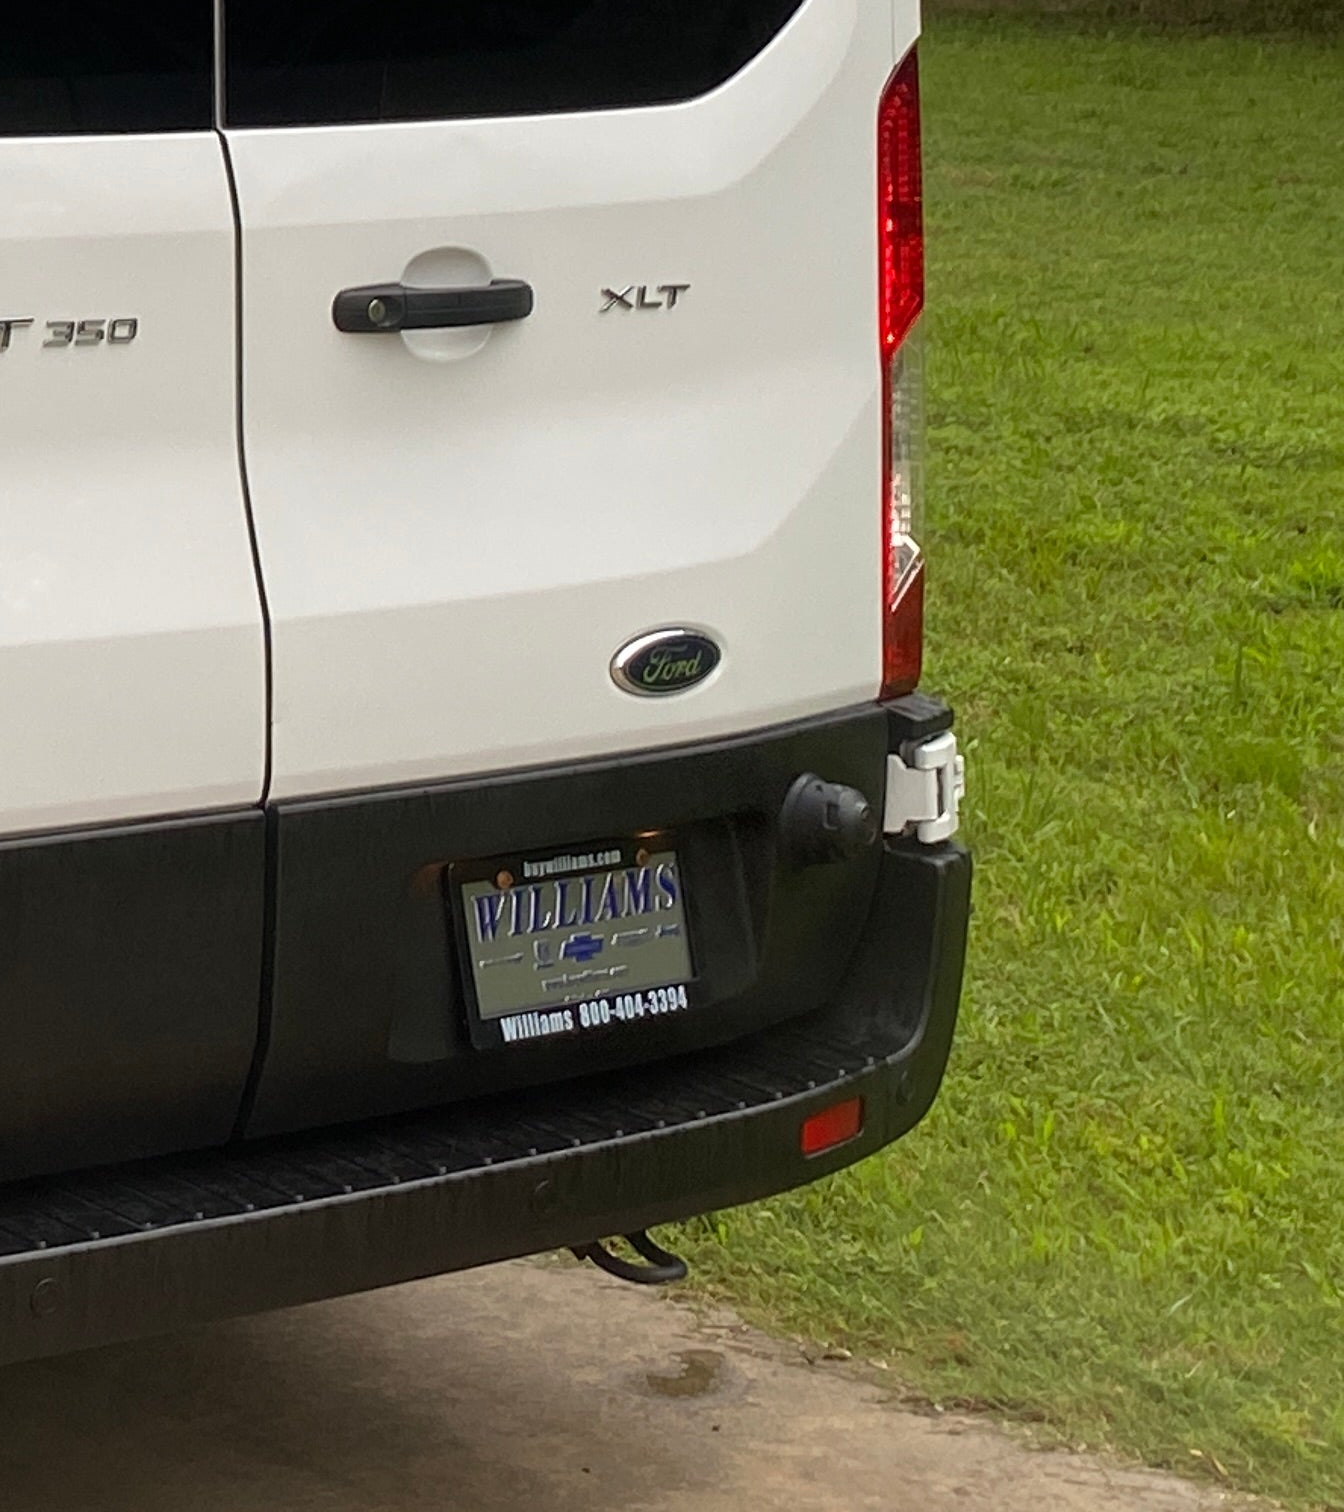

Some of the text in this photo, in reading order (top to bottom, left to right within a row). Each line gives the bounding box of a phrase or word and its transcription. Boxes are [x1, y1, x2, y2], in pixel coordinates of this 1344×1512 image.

[598, 283, 691, 313] XLT
[43, 317, 139, 350] 350
[642, 643, 704, 684] Ford
[471, 862, 678, 944] WILLIAMS
[500, 984, 688, 1043] Williams 800-404-3394
